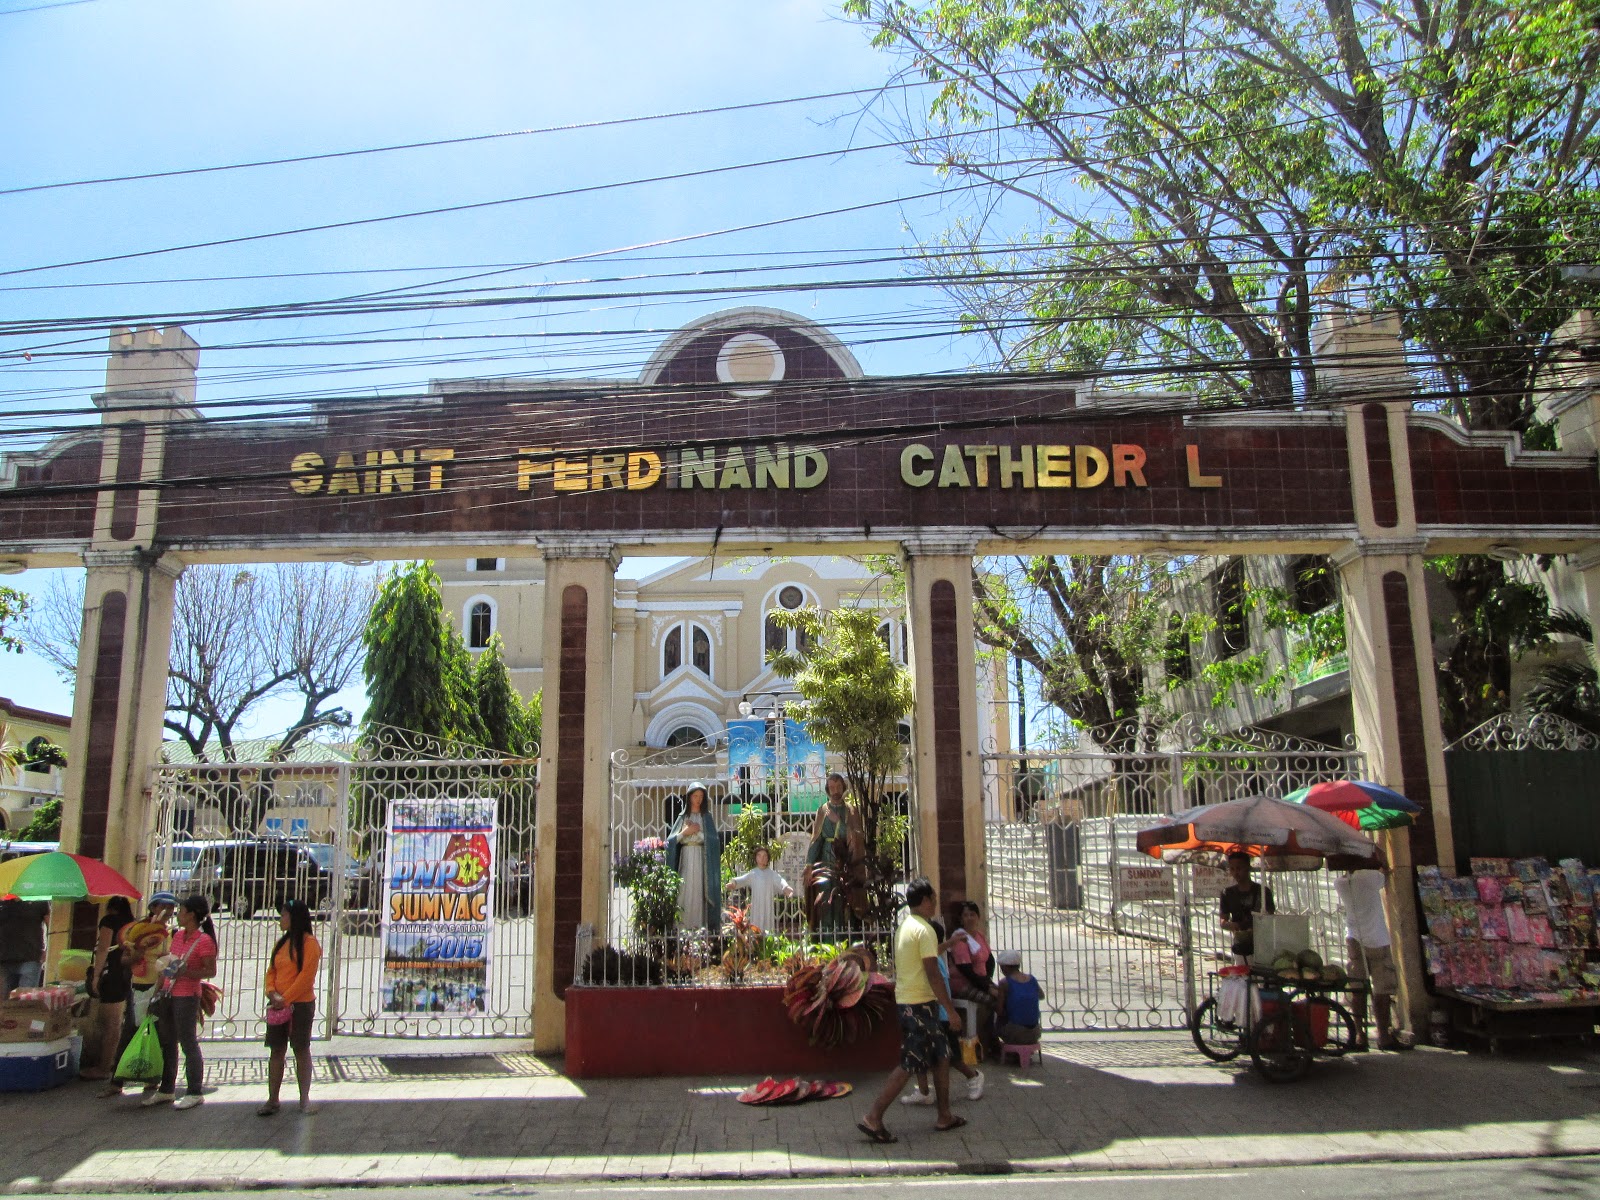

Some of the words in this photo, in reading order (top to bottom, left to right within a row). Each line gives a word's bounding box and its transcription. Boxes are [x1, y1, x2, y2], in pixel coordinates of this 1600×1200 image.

[290, 449, 455, 495] SAINT
[518, 443, 830, 491] FERDINAND
[390, 860, 459, 890] PNP
[1127, 868, 1163, 879] SUNDAY
[390, 892, 487, 921] SUMVAC
[390, 923, 432, 933] SUMMER
[435, 923, 485, 933] VACATION
[424, 935, 484, 958] 2015
